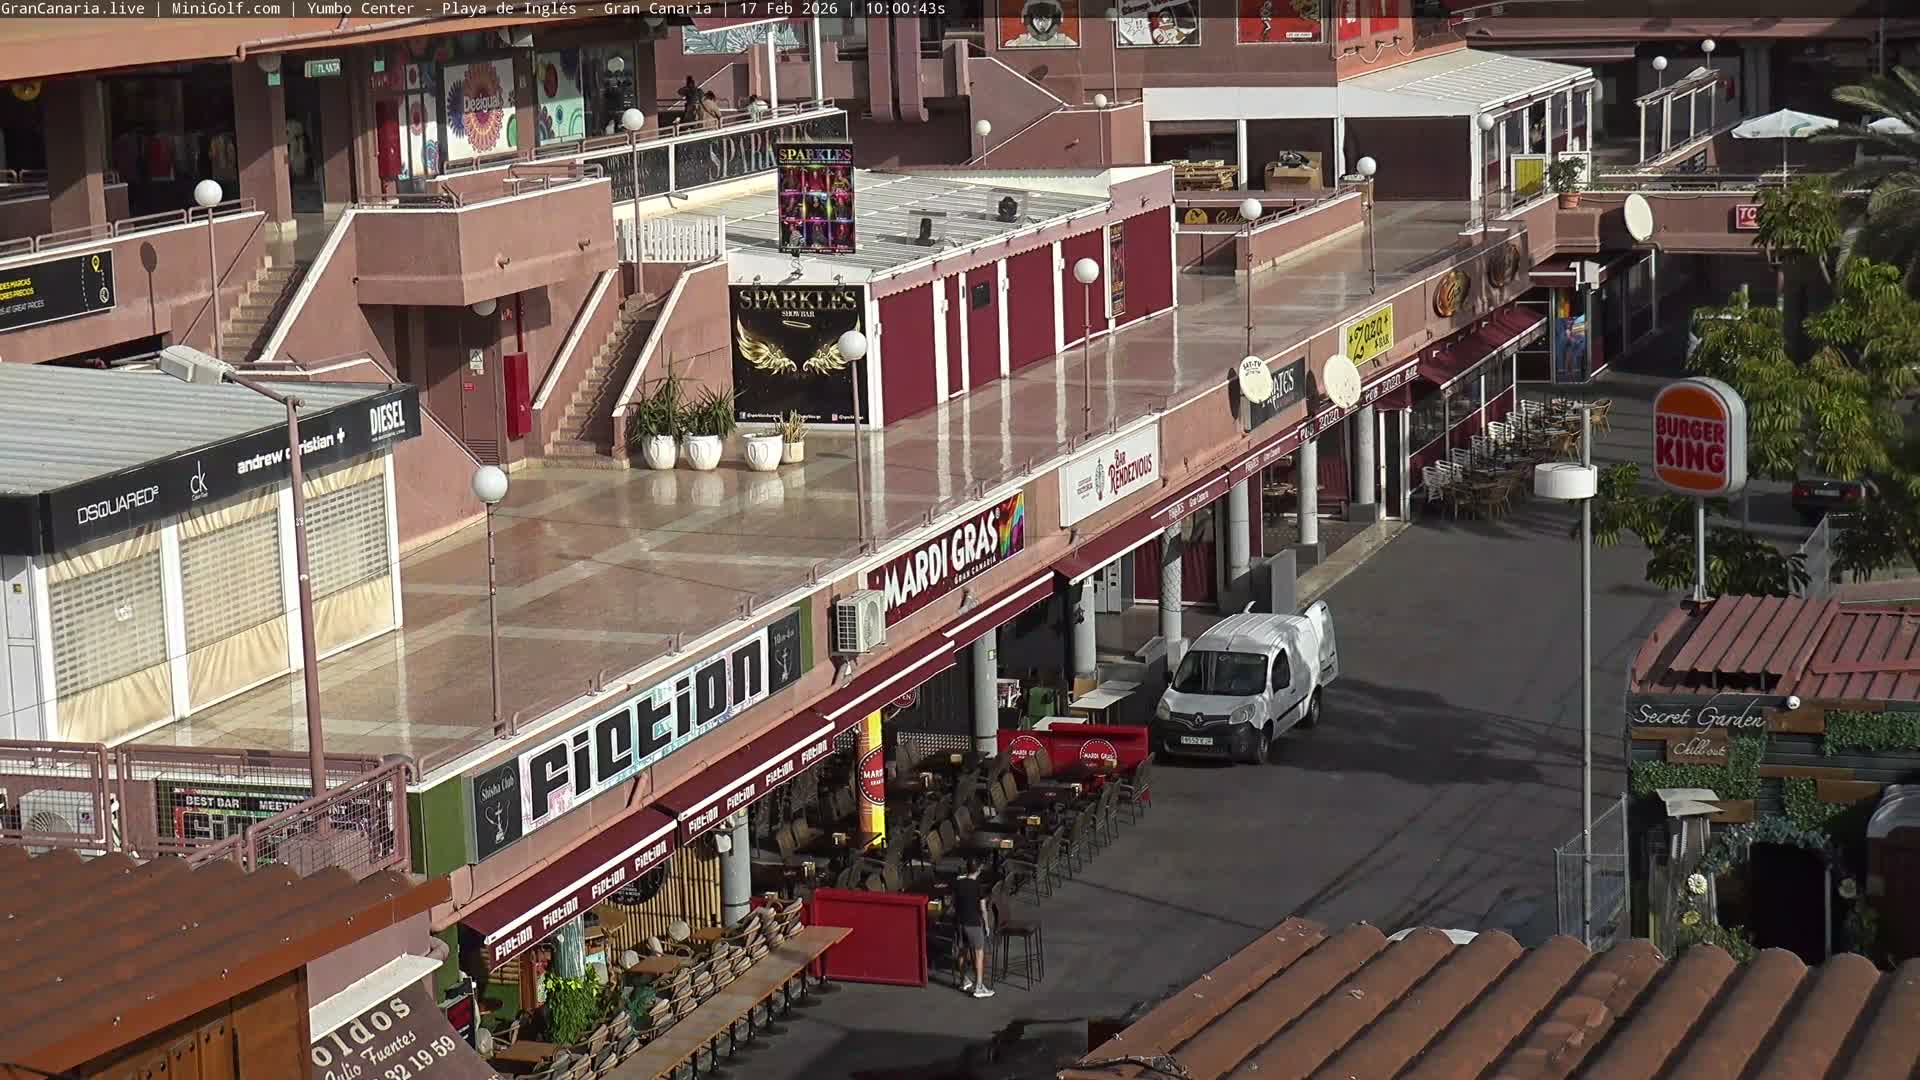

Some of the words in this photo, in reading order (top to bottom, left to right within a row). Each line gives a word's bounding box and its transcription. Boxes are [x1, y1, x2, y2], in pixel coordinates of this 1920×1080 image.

[779, 149, 853, 161] SPARKLES
[740, 289, 857, 311] SPARKLES
[370, 400, 406, 436] DIESEL
[1656, 415, 1725, 444] BURGER
[237, 449, 283, 475] andrew
[285, 434, 334, 460] cristian
[1656, 436, 1726, 473] KING
[190, 460, 208, 494] ck
[1108, 453, 1153, 495] RENDEZVOUS
[884, 537, 949, 612] MARDI
[1634, 704, 1691, 723] Secret
[1697, 697, 1767, 735] Garden
[185, 795, 214, 807] BEST
[216, 798, 240, 809] BAR
[360, 1029, 417, 1066] Fuentes
[408, 1049, 434, 1072] 19
[430, 1034, 456, 1057] 59
